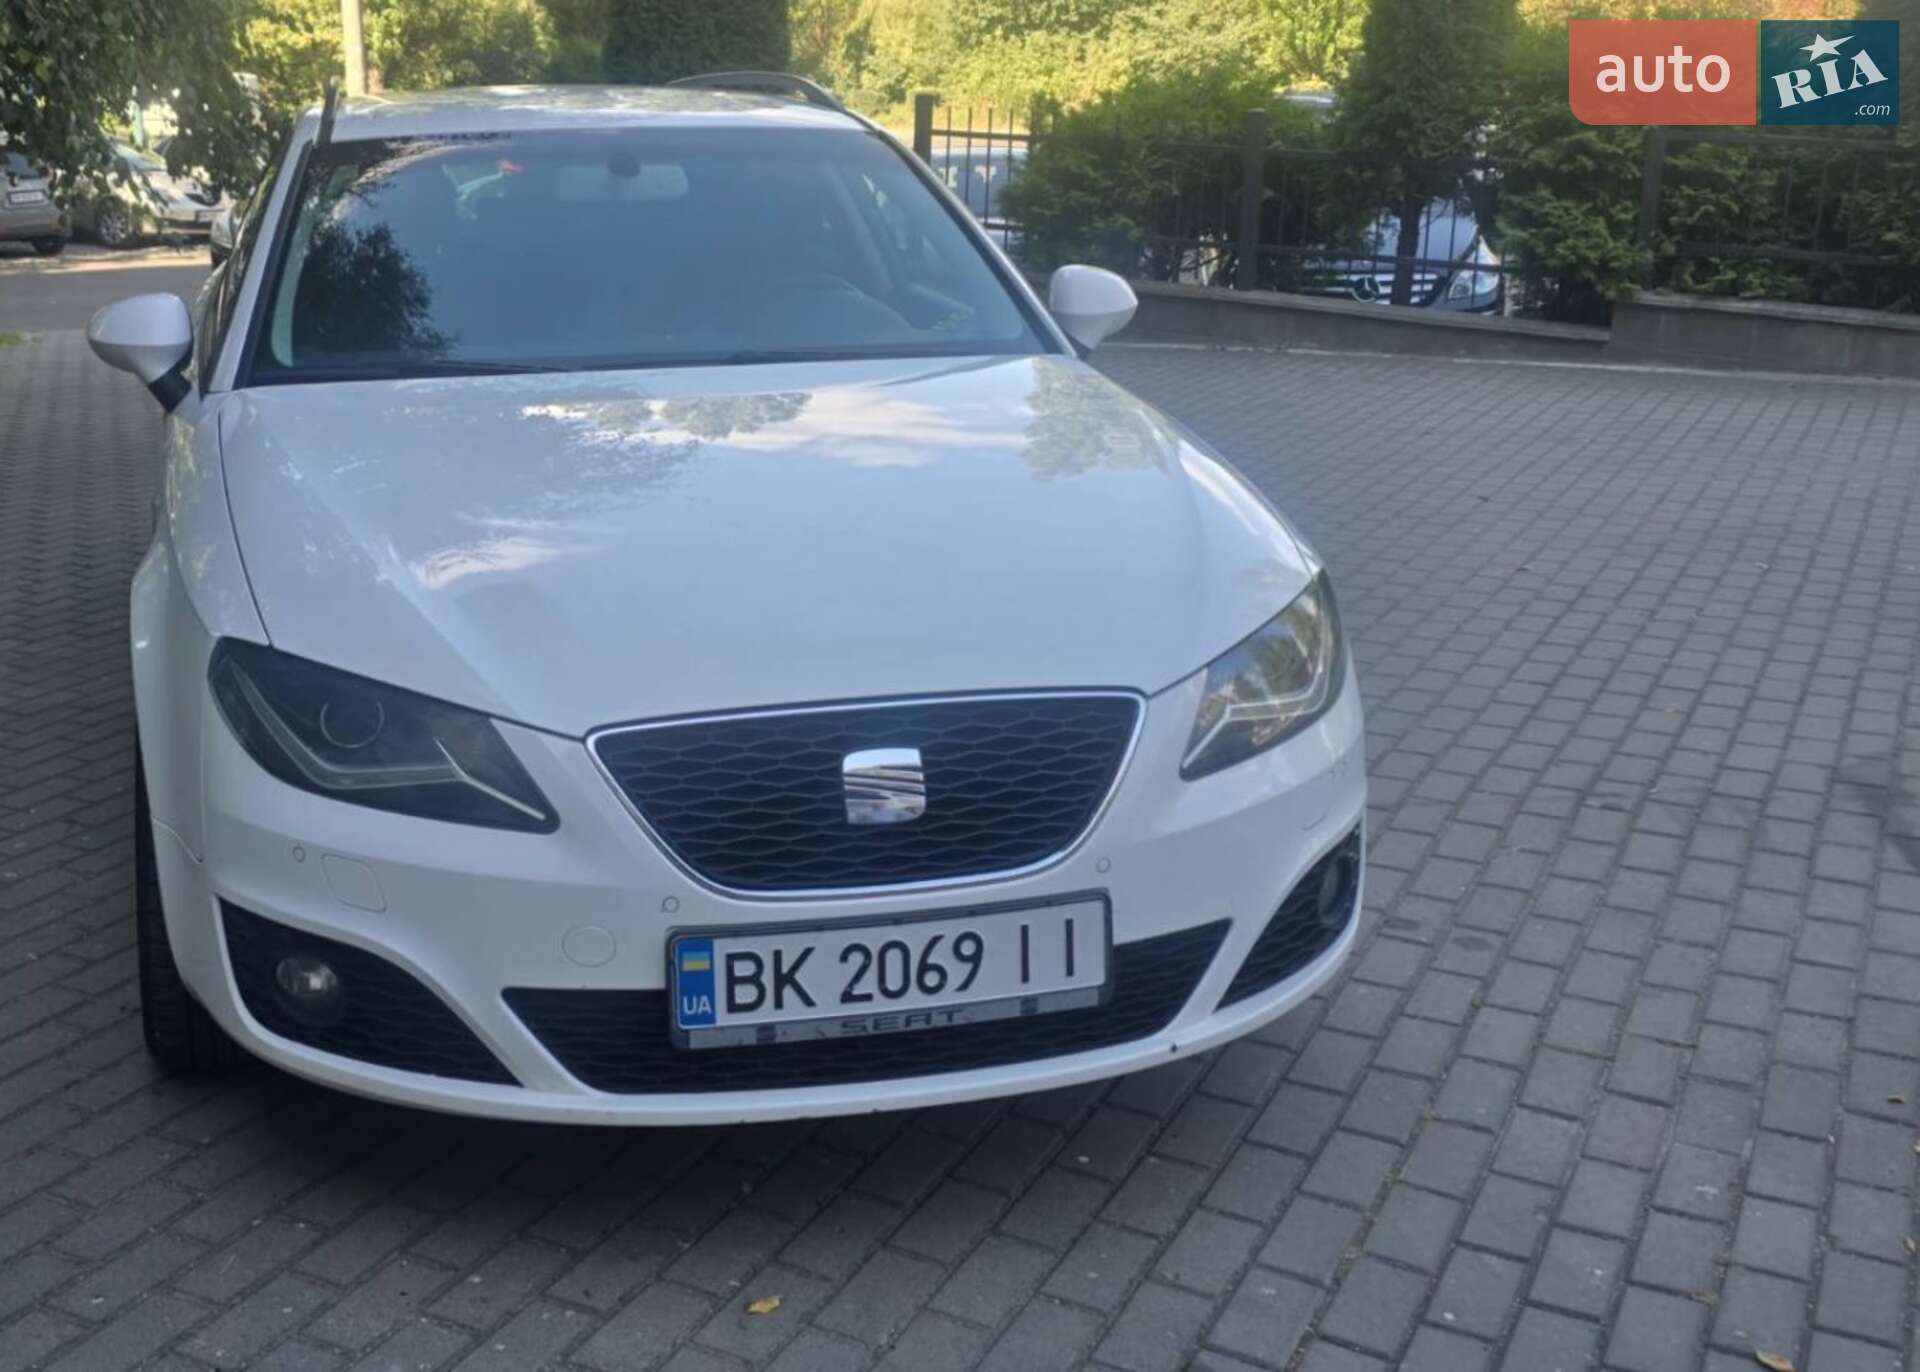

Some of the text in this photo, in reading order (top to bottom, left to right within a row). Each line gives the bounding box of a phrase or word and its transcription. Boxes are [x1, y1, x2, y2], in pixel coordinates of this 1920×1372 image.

[725, 946, 817, 1014] BK
[838, 931, 985, 1005] 2069
[682, 995, 713, 1015] UA
[839, 1008, 965, 1036] SEAT
